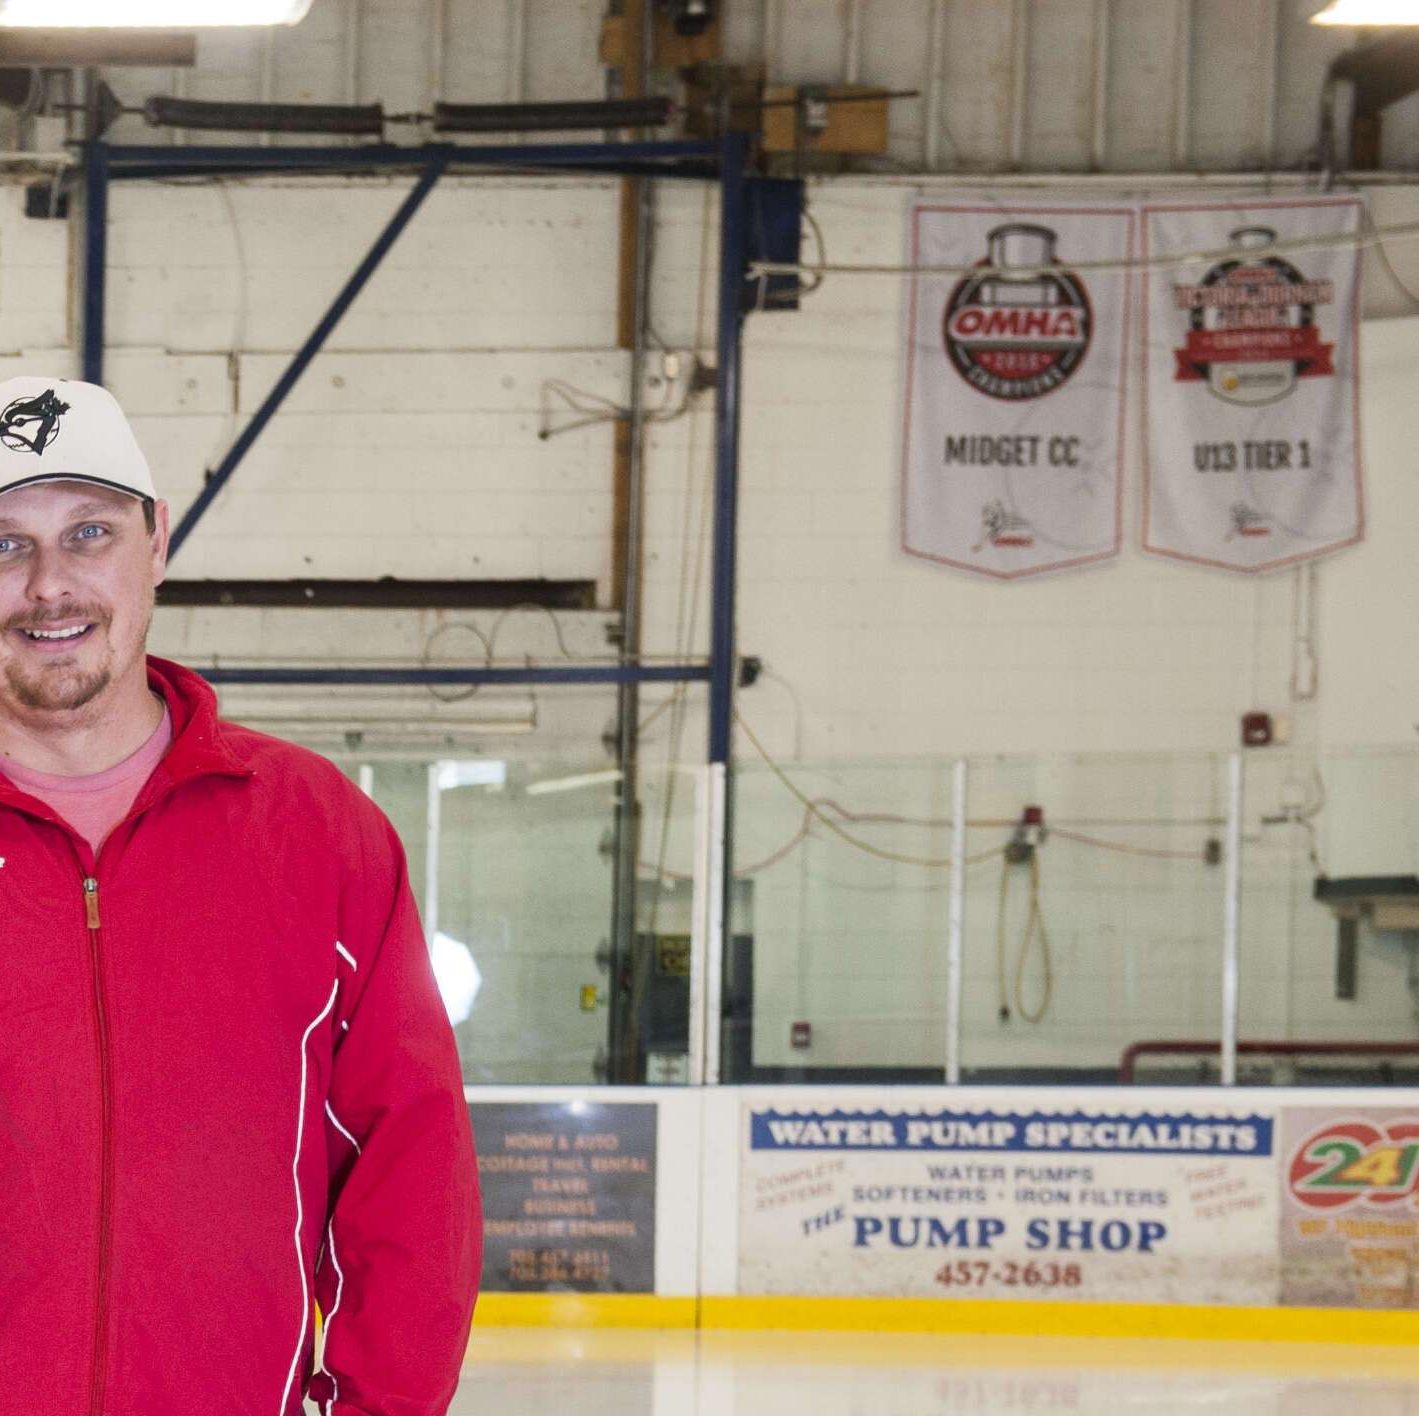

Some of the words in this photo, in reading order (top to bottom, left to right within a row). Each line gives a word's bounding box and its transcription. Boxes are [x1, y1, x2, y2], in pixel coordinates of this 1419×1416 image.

[954, 308, 1078, 337] OMHA
[944, 434, 1043, 471] MIDGET
[1048, 434, 1080, 470] CC
[1194, 441, 1236, 472] U13
[1242, 440, 1293, 472] TIER
[1298, 439, 1312, 470] 1
[768, 1119, 898, 1146] WATER
[906, 1120, 1017, 1148] PUMP
[1024, 1121, 1257, 1151] SPECIALISTS
[756, 1159, 846, 1191] COMPLETE
[927, 1163, 1006, 1183] WATER
[1014, 1166, 1094, 1183] PUMPS
[851, 1185, 988, 1205] SOFTENERS
[1014, 1189, 1071, 1206] IRON
[1079, 1190, 1169, 1208] FILTERS
[802, 1203, 847, 1237] THE
[853, 1215, 1006, 1250] PUMP
[1025, 1218, 1168, 1254] SHOP
[935, 1260, 1083, 1289] 457-2638
